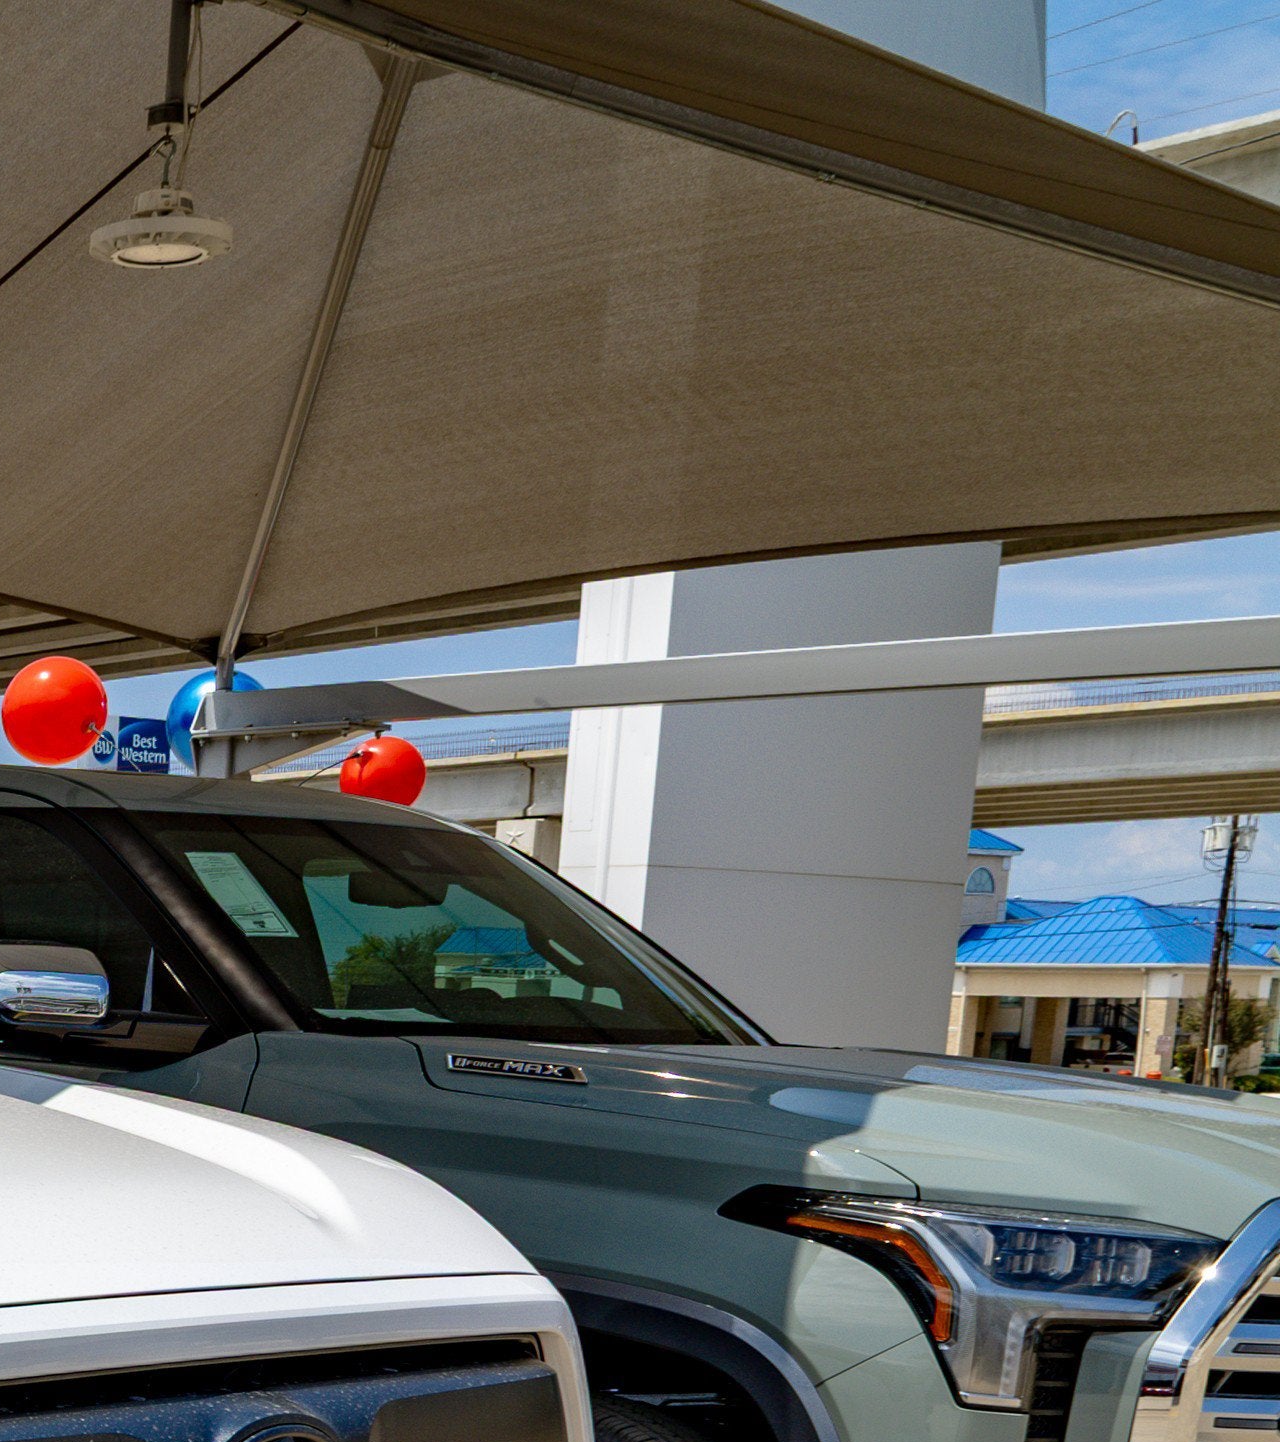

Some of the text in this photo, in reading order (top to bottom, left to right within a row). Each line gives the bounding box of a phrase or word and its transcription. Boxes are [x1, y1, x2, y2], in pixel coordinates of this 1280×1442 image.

[94, 741, 113, 755] BW
[132, 734, 158, 749] Best
[121, 747, 167, 764] Western
[502, 1061, 565, 1077] MAX
